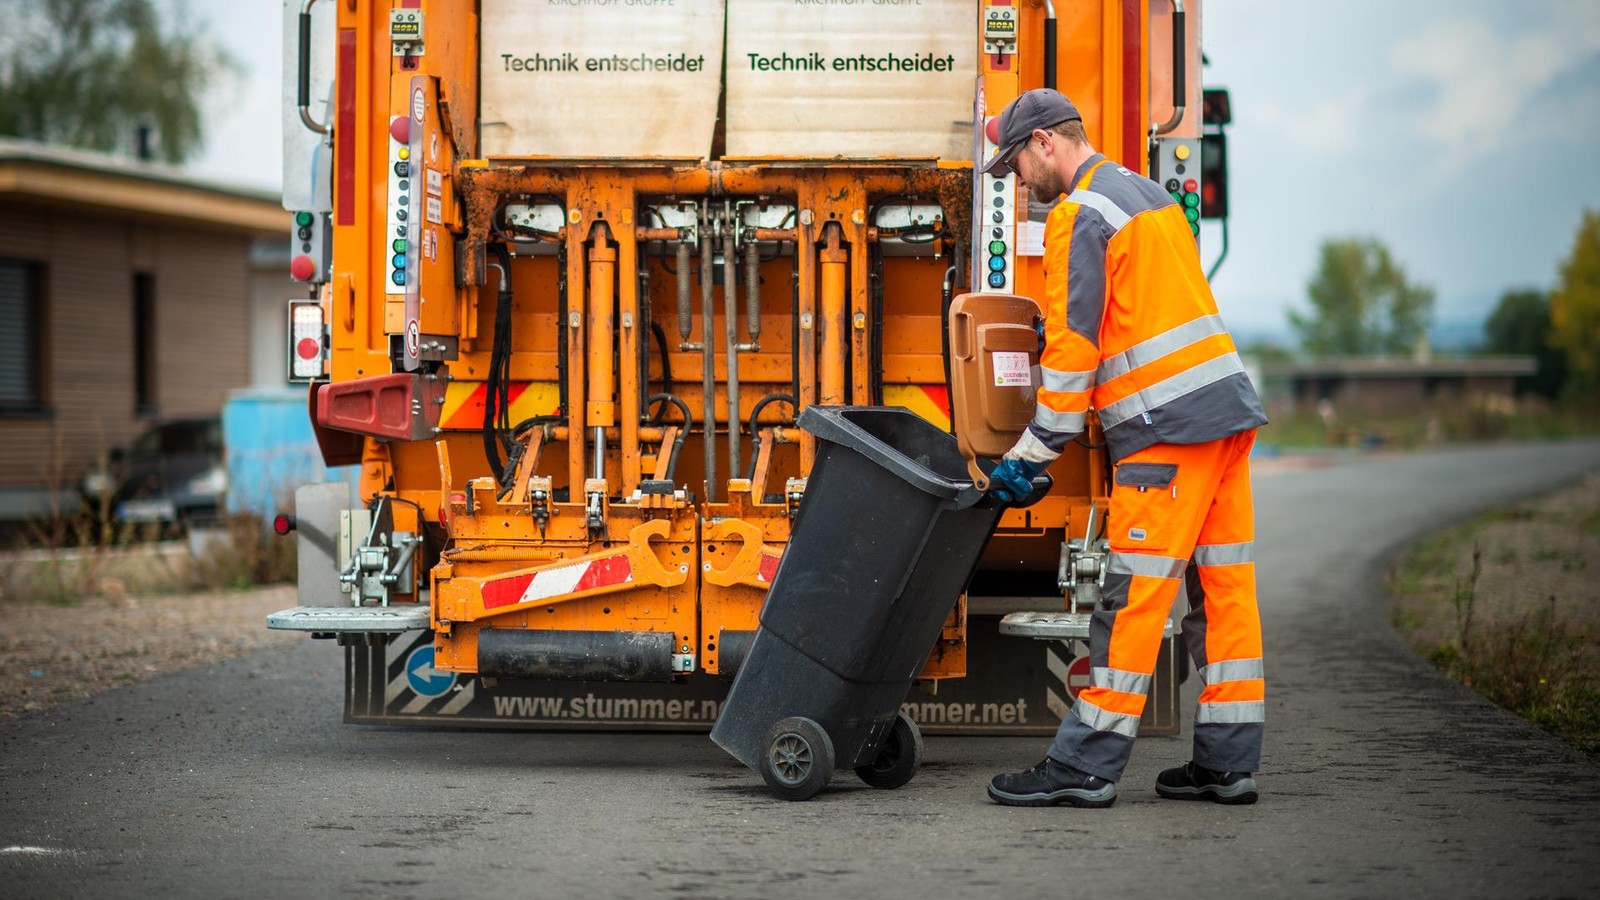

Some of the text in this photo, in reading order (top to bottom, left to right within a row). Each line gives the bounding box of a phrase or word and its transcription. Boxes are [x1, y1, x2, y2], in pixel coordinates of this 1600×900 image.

[988, 21, 1014, 29] MOBA
[501, 53, 705, 72] Technik entscheidet
[747, 52, 955, 72] Technik entscheidet
[493, 693, 725, 720] www.stummer.n
[899, 698, 1028, 724] mmer.net
